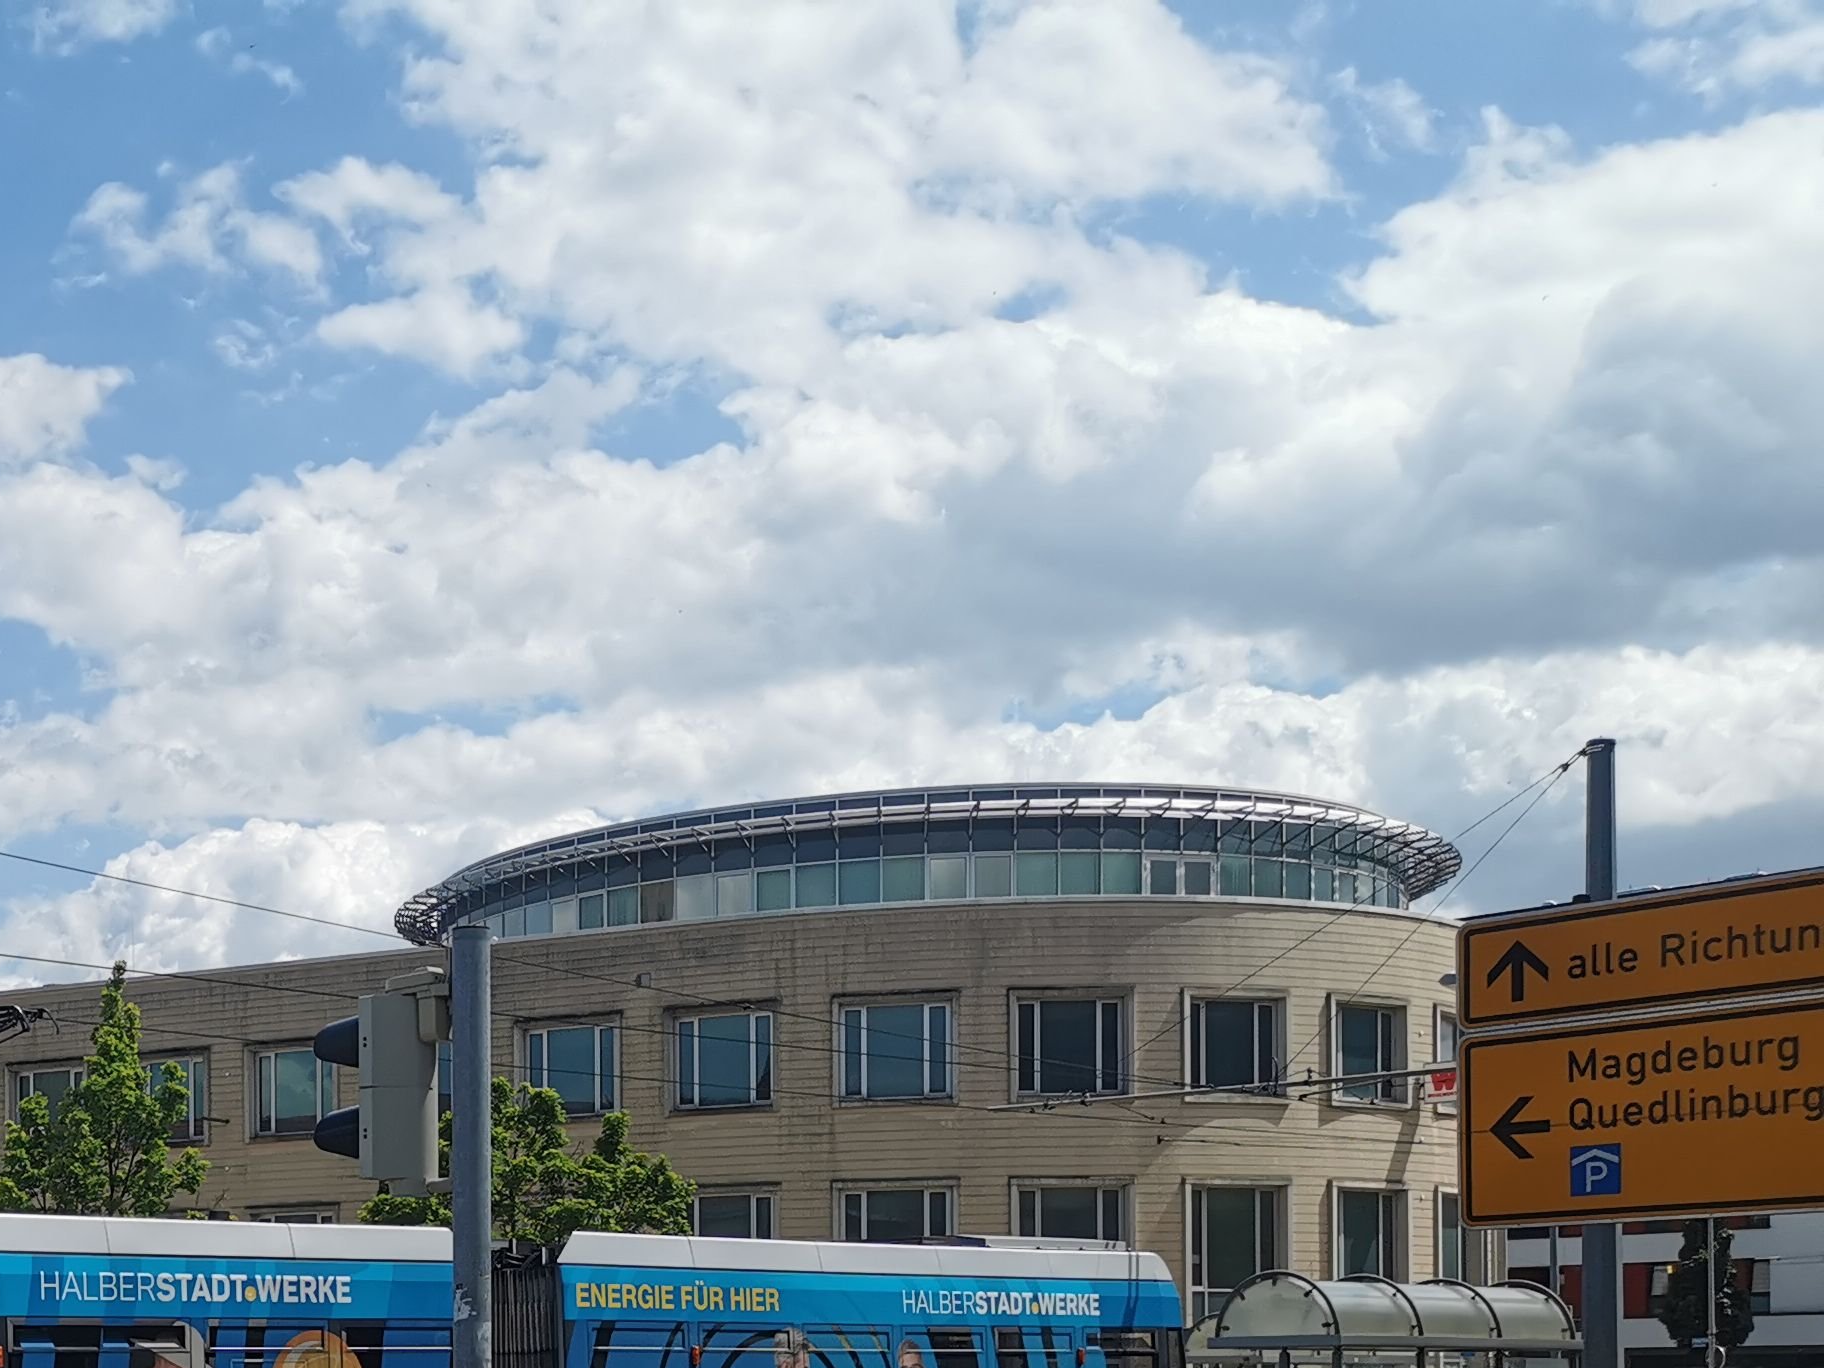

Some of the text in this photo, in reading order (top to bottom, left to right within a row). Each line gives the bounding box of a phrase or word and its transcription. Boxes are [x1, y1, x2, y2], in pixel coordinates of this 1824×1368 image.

[1567, 923, 1821, 979] alle Richtun
[1567, 1035, 1799, 1085] Magdeburg
[1568, 1084, 1824, 1131] Quedlinburg
[1585, 1161, 1608, 1193] P
[576, 1280, 780, 1312] ENERGIE FÜR HIER
